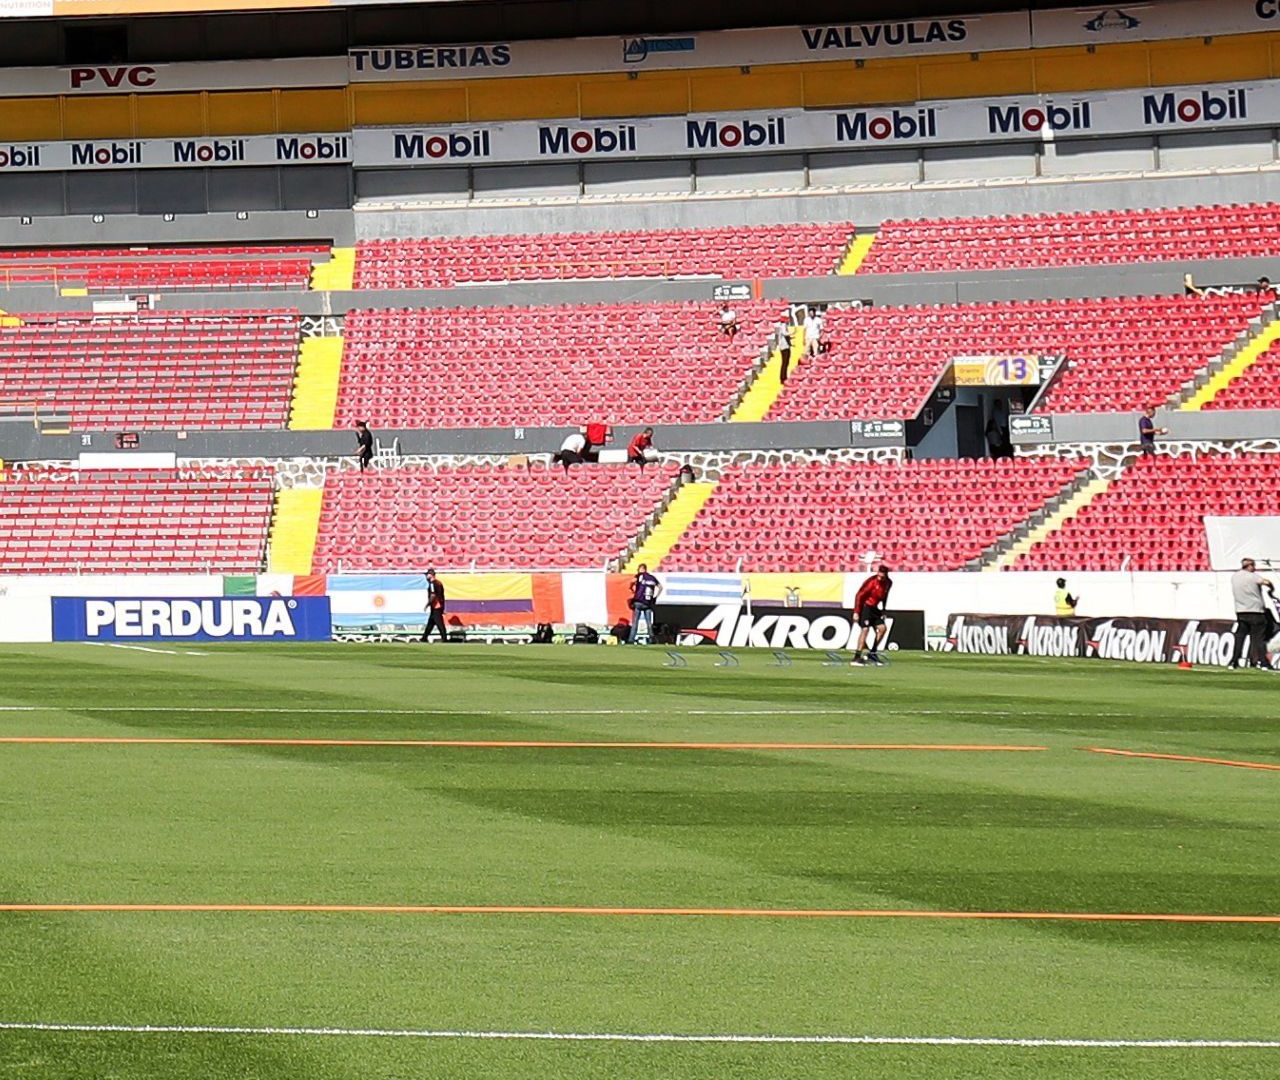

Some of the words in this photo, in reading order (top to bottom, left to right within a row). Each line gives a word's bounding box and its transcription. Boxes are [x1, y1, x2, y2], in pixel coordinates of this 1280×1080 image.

[0, 1, 50, 9] NUTRITION
[802, 20, 967, 50] VALVULAS
[351, 45, 511, 71] TUBERIAS
[71, 67, 156, 88] PVC
[394, 130, 490, 159] Mobil
[540, 126, 635, 154] Mobil
[687, 117, 785, 148] Mobil
[836, 108, 936, 141] Mobil
[988, 101, 1090, 134] Mobil
[1143, 89, 1246, 124] Mobil
[71, 142, 141, 165] Mobil
[173, 139, 243, 162] Mobil
[276, 136, 347, 159] Mobil
[998, 358, 1026, 380] 13
[86, 600, 295, 637] PERDURA
[947, 616, 1008, 654] AKRON
[1017, 617, 1077, 657] AKRON
[1087, 620, 1163, 662] AKRON
